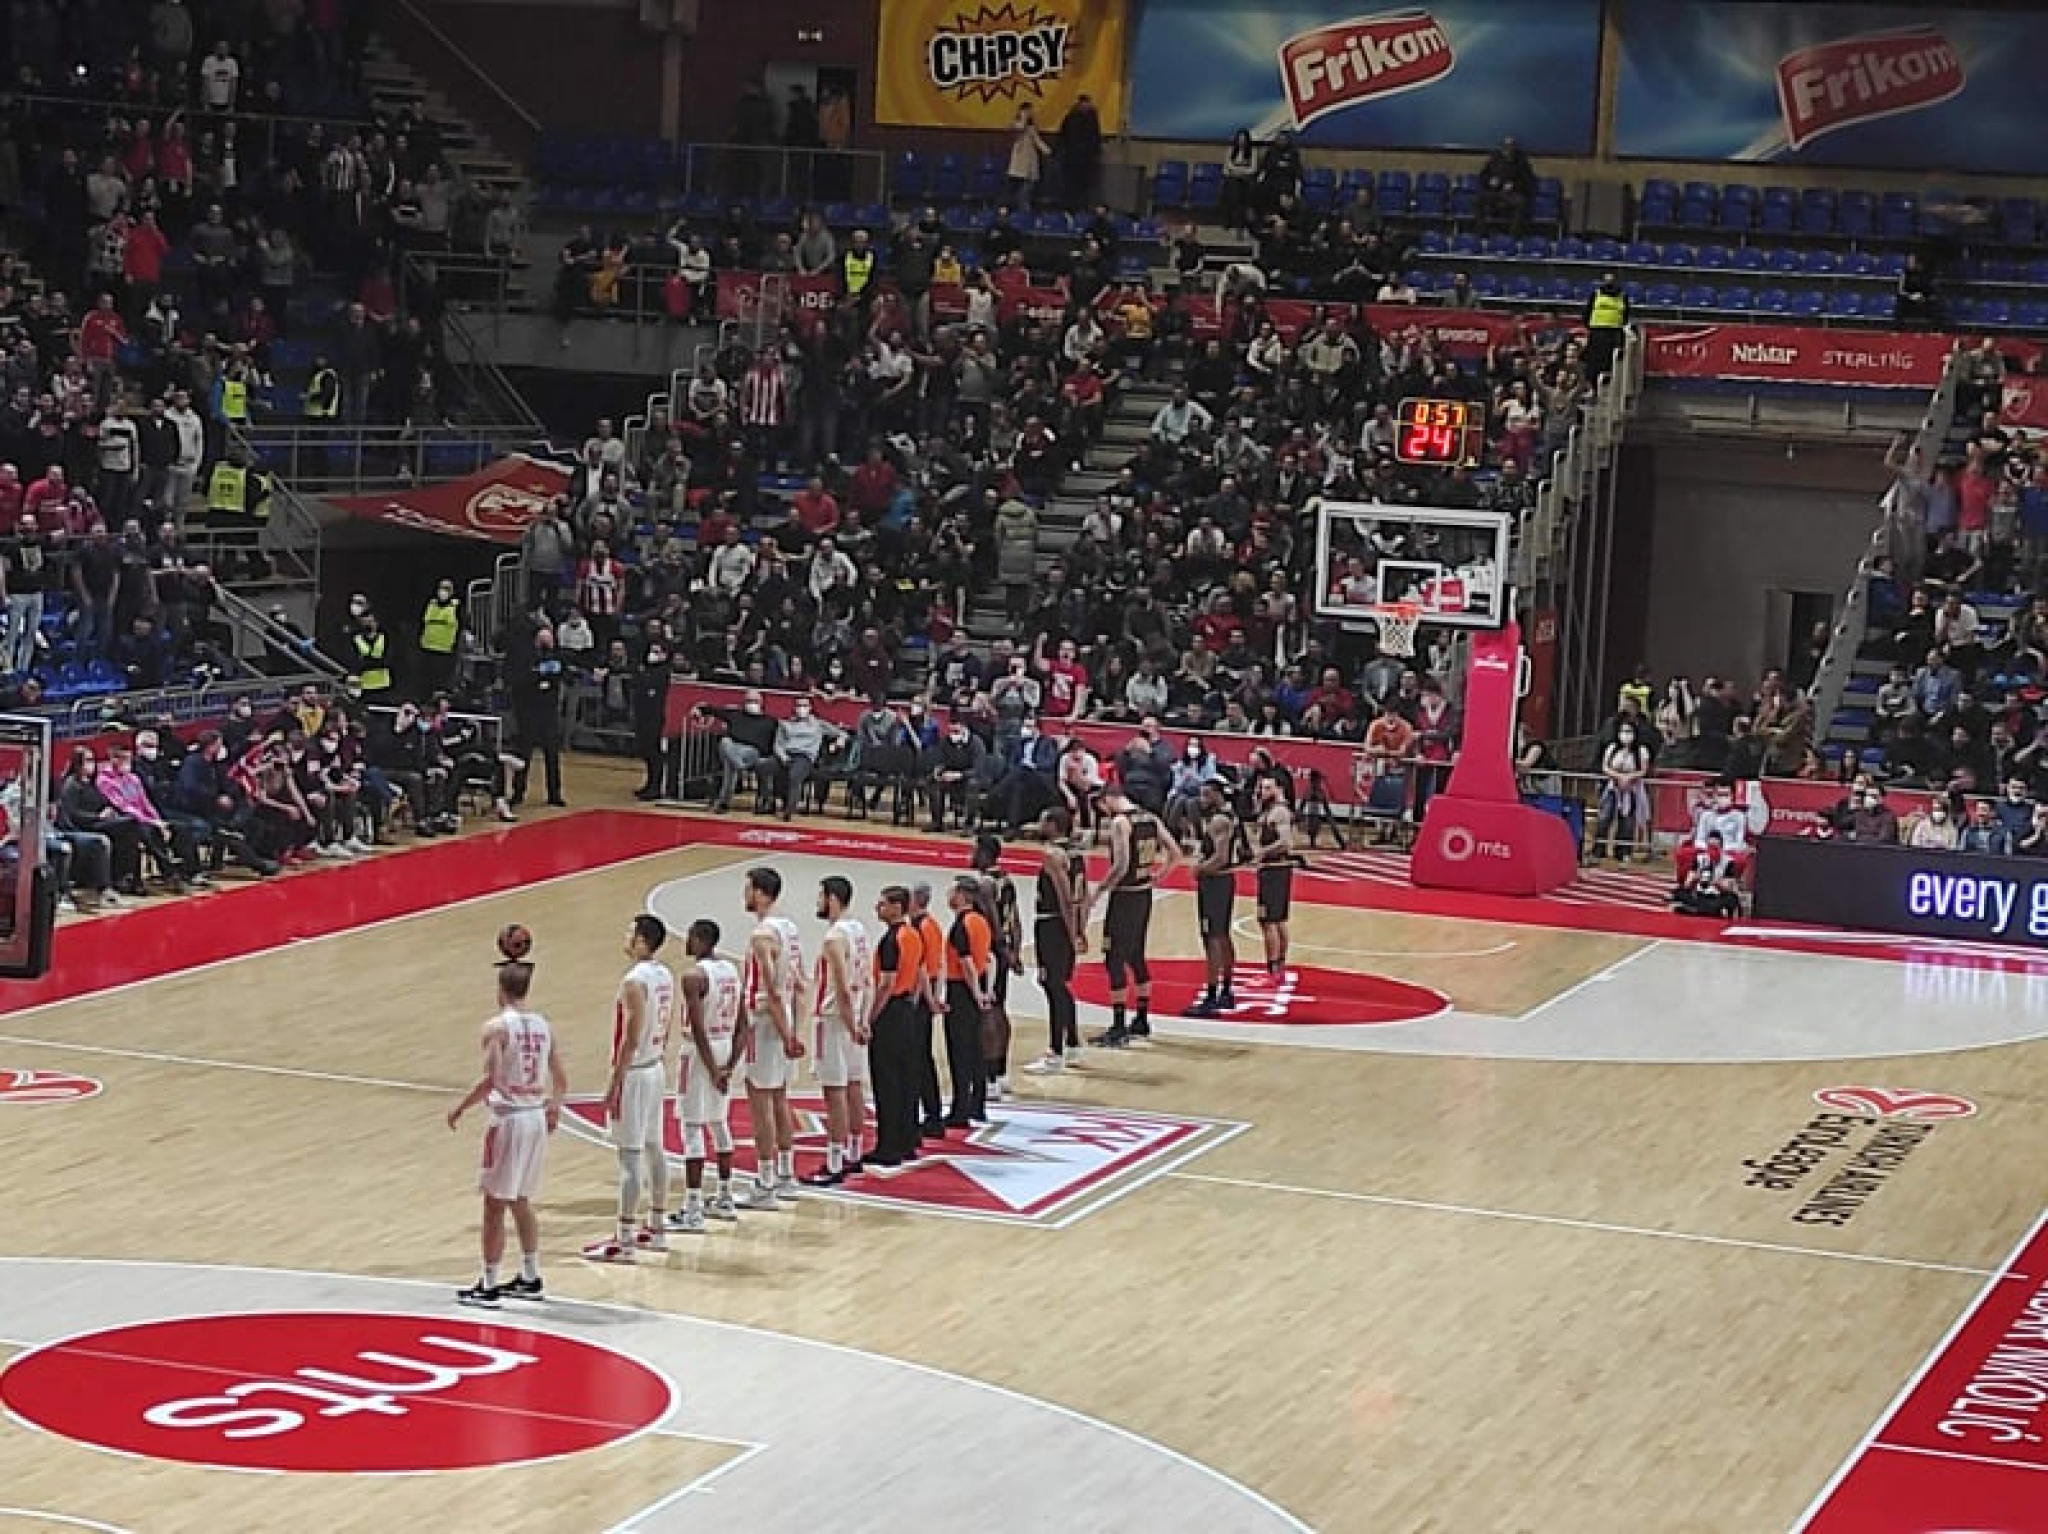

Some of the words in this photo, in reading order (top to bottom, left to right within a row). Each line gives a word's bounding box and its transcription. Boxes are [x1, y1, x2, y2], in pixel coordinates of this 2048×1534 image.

[1293, 27, 1446, 102] Frikom
[1791, 45, 1955, 120] Frikom
[1822, 350, 1913, 370] STERLING
[1410, 424, 1450, 458] 24
[1415, 403, 1464, 425] 0:57
[1909, 872, 2018, 933] every
[143, 1335, 540, 1438] mts
